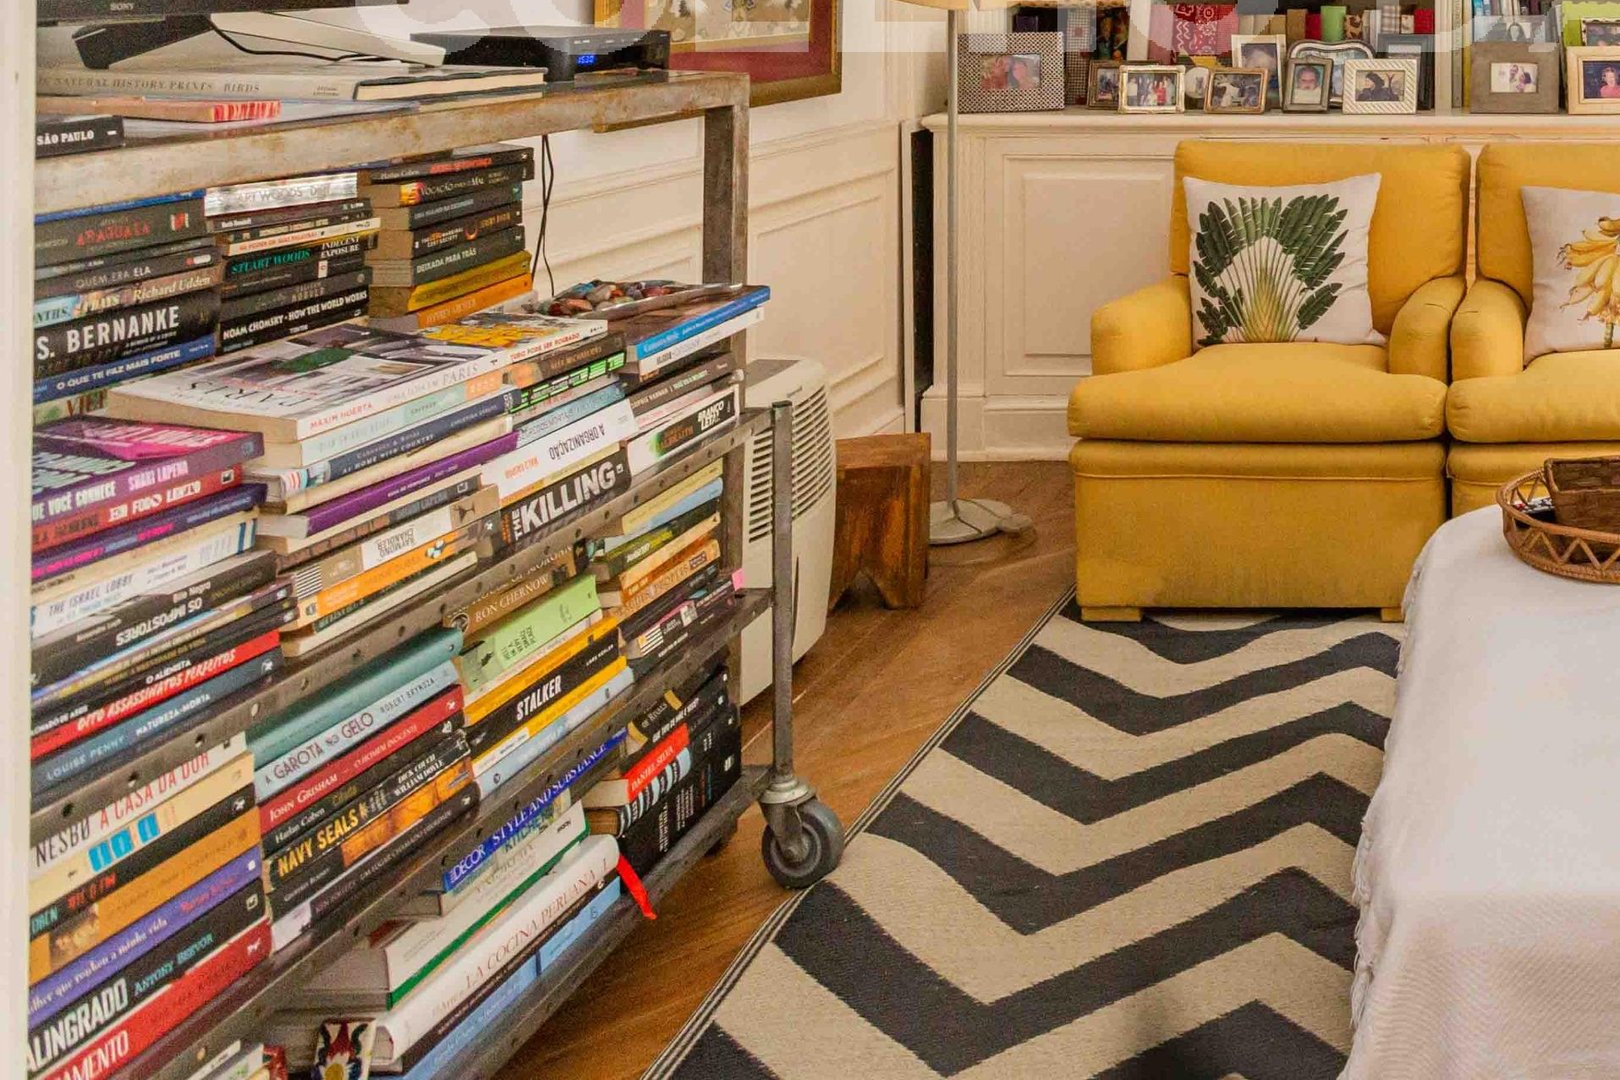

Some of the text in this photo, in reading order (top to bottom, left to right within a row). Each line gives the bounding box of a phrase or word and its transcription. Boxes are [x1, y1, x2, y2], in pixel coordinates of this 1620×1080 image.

[110, 1, 135, 12] SONY
[112, 77, 165, 90] HISTORY
[169, 79, 213, 91] PRINTS
[223, 82, 260, 94] BIRDS
[36, 129, 95, 146] SÃO PAULO
[230, 249, 311, 274] STUART WOODS
[320, 244, 360, 259] EXPOSURE
[321, 235, 360, 251] INDECENT
[416, 247, 477, 274] DEIXADA PARA TRÁS
[74, 265, 151, 289] QUEM ERA ELA
[132, 281, 177, 302] Richard
[36, 335, 56, 360] S.
[66, 305, 180, 354] BERNANKE
[223, 325, 248, 341] NOAM
[248, 315, 285, 332] CHOMSKY
[288, 308, 307, 322] HOW
[307, 303, 321, 315] THE
[321, 297, 345, 312] WORLD
[343, 290, 368, 306] WORKS
[56, 349, 182, 390] O QUE TE FAZ MAIS FORTE
[309, 402, 374, 430] MAXIM HUERTA
[697, 400, 726, 422] BRANCO
[354, 454, 379, 470] HOME
[379, 447, 399, 461] WITH
[400, 433, 435, 452] COUNTRY
[547, 423, 606, 461] A ORGANIZAÇÃO
[48, 460, 189, 516] VOCÊ CONHECE SHARI LAPENA
[511, 508, 523, 541] THE
[519, 461, 616, 535] KILLING
[48, 574, 135, 617] THE ISRAEL LOBBY
[187, 596, 203, 613] OS
[474, 574, 551, 624] RON CHERNOW
[115, 604, 187, 647] IMPOSTORES
[76, 647, 237, 732] OITO ASSASSINATOS PERFEITOS
[145, 659, 192, 684] O ALIENISTA
[134, 693, 212, 737] NATUREZA-MORTA
[515, 674, 564, 721] STALKER
[46, 734, 127, 781] LOUISE PENNY
[264, 776, 272, 785] A
[272, 742, 324, 779] GAROTA
[340, 711, 375, 740] GELO
[378, 694, 406, 715] ROBERT
[98, 752, 211, 831] A CASA DA DOR
[268, 800, 296, 822] JOHN
[296, 772, 339, 805] GRISHAM
[393, 758, 446, 797] WILLIAM DOYLE
[273, 824, 300, 845] Harlan
[300, 806, 326, 826] Coben
[452, 743, 609, 883] DECOR STYLE AND SUBSTANCE
[277, 809, 360, 878] NAVY SEALS
[148, 915, 169, 935] vida
[465, 964, 485, 989] LA
[486, 917, 539, 971] COCINA
[25, 931, 214, 1072] ALINGRADO ANTONY BEEVOR
[58, 1029, 130, 1080] AMENTO
